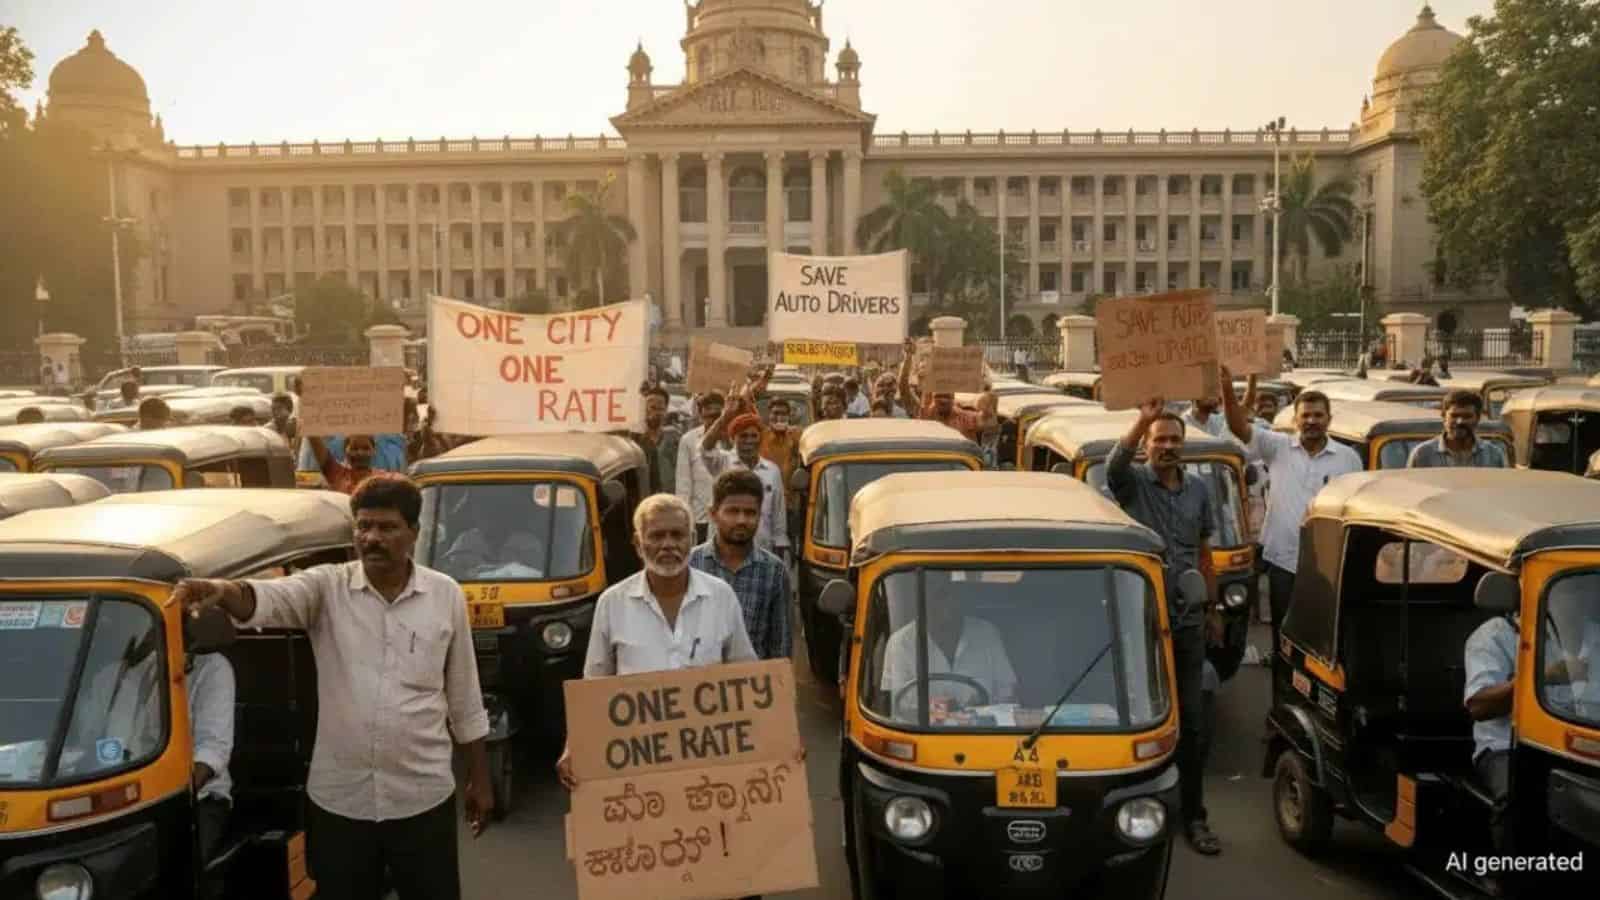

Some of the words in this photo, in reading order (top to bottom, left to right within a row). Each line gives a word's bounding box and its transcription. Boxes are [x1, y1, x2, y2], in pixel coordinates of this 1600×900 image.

[800, 265, 848, 286] SAVE
[775, 290, 821, 313] AUTO
[457, 311, 525, 345] ONE
[547, 311, 623, 345] CITY
[500, 355, 564, 384] ONE
[538, 388, 626, 422] RATE
[608, 686, 686, 727] ONE
[693, 674, 774, 716] CITY
[606, 731, 672, 770] ONE
[680, 721, 755, 760] RATE
